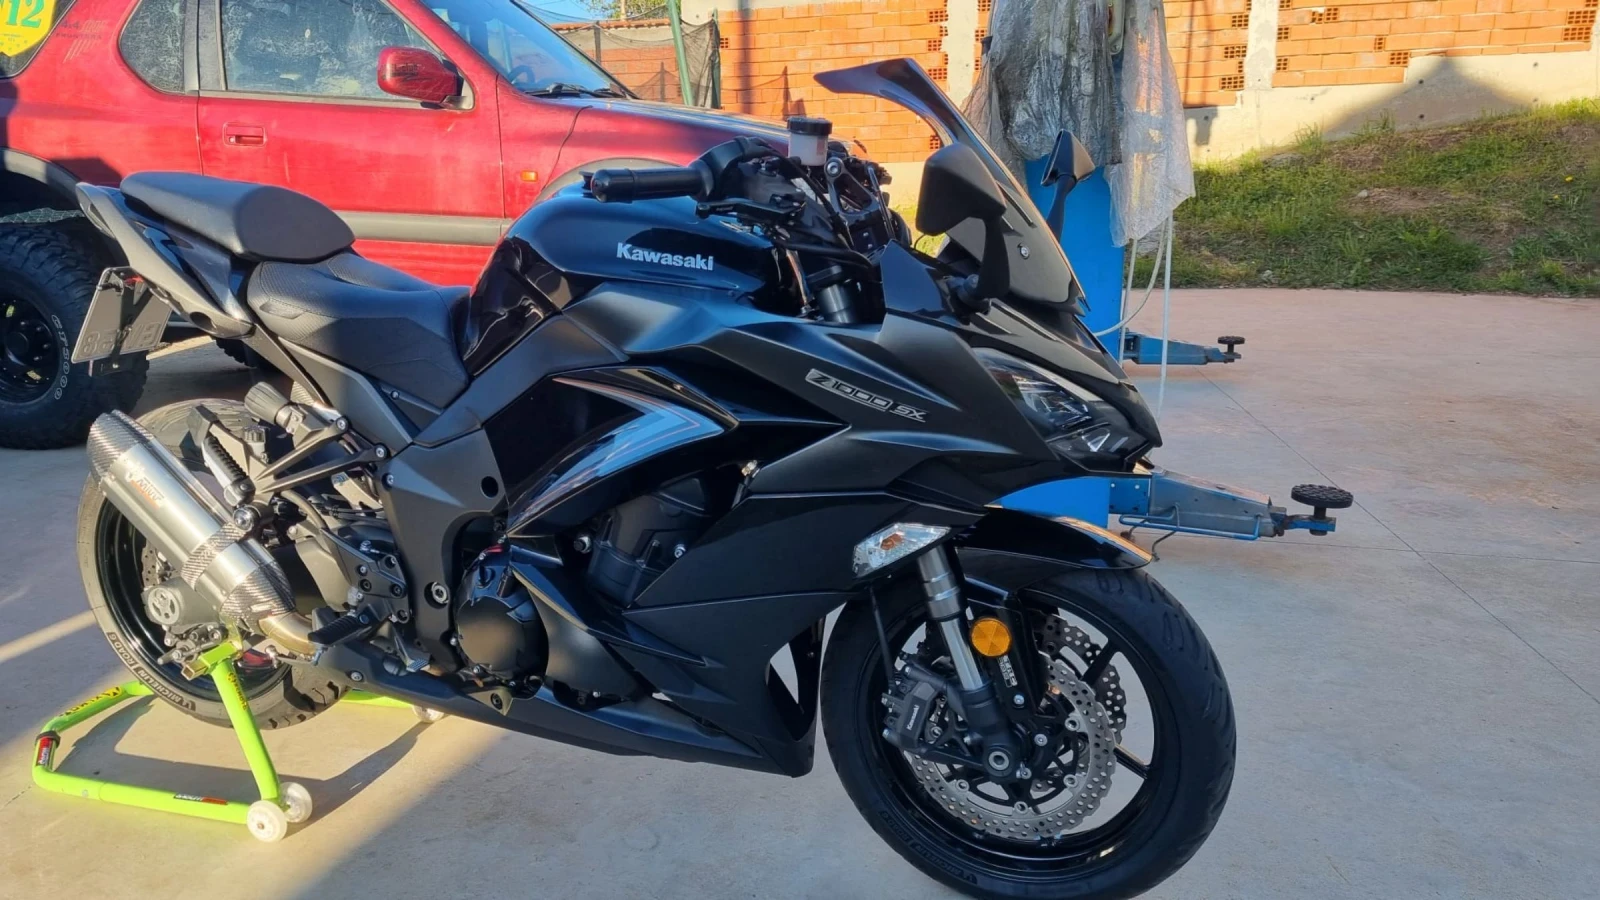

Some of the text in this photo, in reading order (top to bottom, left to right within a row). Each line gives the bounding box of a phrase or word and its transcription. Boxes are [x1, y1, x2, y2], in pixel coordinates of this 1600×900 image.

[616, 242, 714, 271] Kawasaki
[806, 368, 927, 421] Z1000 SX
[108, 632, 182, 702] MICHELIN ROAD 6
